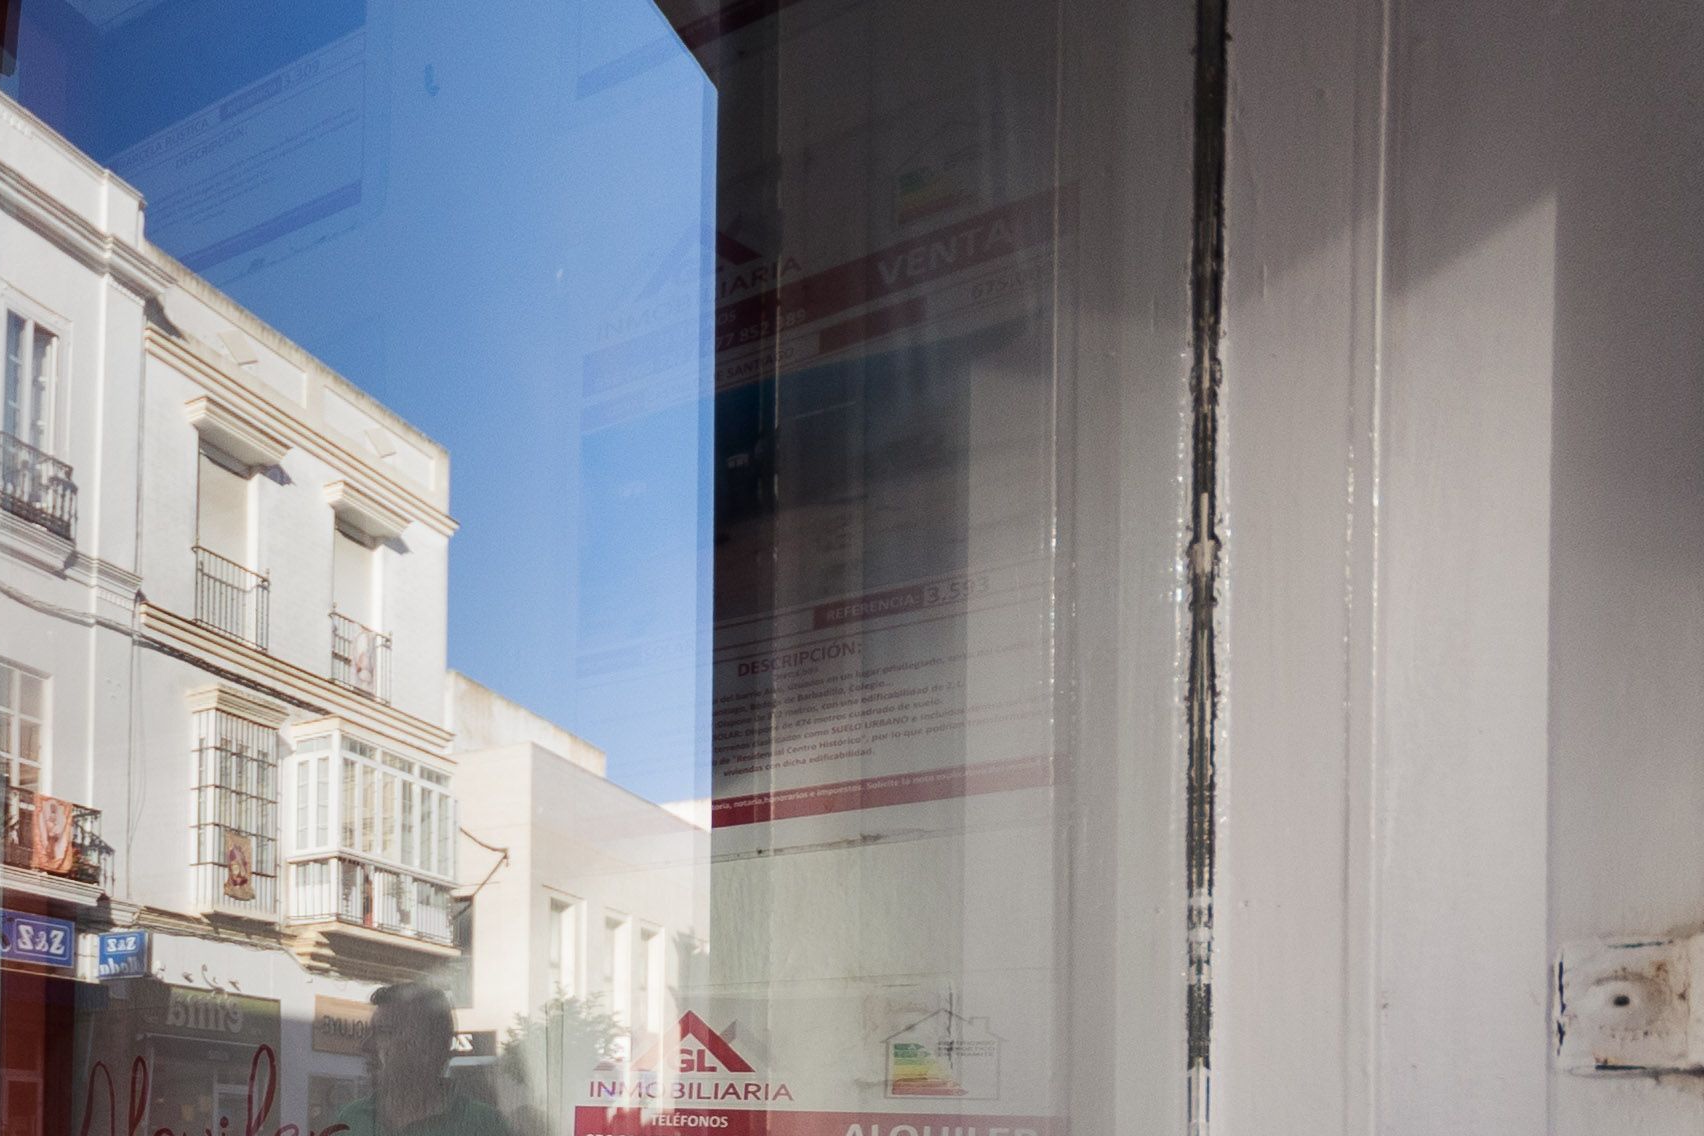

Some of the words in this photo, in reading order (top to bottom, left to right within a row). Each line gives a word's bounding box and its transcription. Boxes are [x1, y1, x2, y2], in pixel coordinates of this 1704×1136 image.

[737, 640, 863, 678] DESCRIPCIÓN:
[677, 1049, 717, 1073] GL
[589, 1080, 794, 1102] INMOBILIARIA
[651, 1112, 728, 1130] TELÉFONOS
